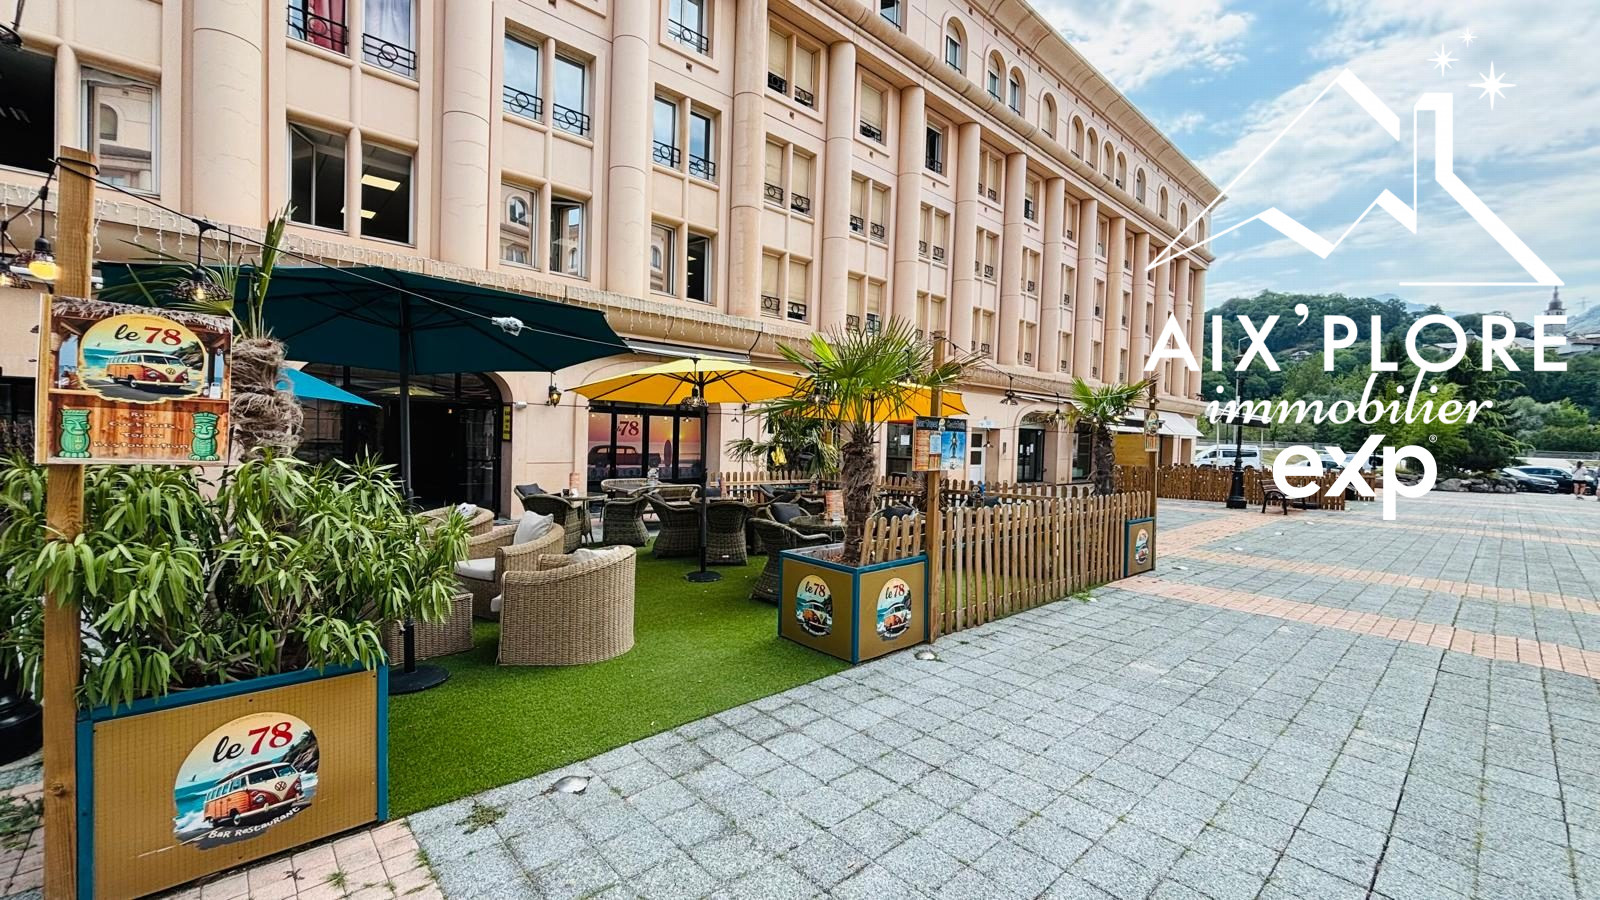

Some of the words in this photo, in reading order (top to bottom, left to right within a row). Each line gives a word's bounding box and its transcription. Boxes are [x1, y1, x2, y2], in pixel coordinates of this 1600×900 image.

[114, 323, 140, 342] le
[143, 326, 182, 346] 78
[619, 420, 639, 436] 78
[805, 581, 813, 593] le
[813, 583, 826, 597] 78
[885, 587, 892, 599] le
[893, 583, 905, 598] 78
[213, 737, 244, 762] le
[248, 722, 293, 754] 78
